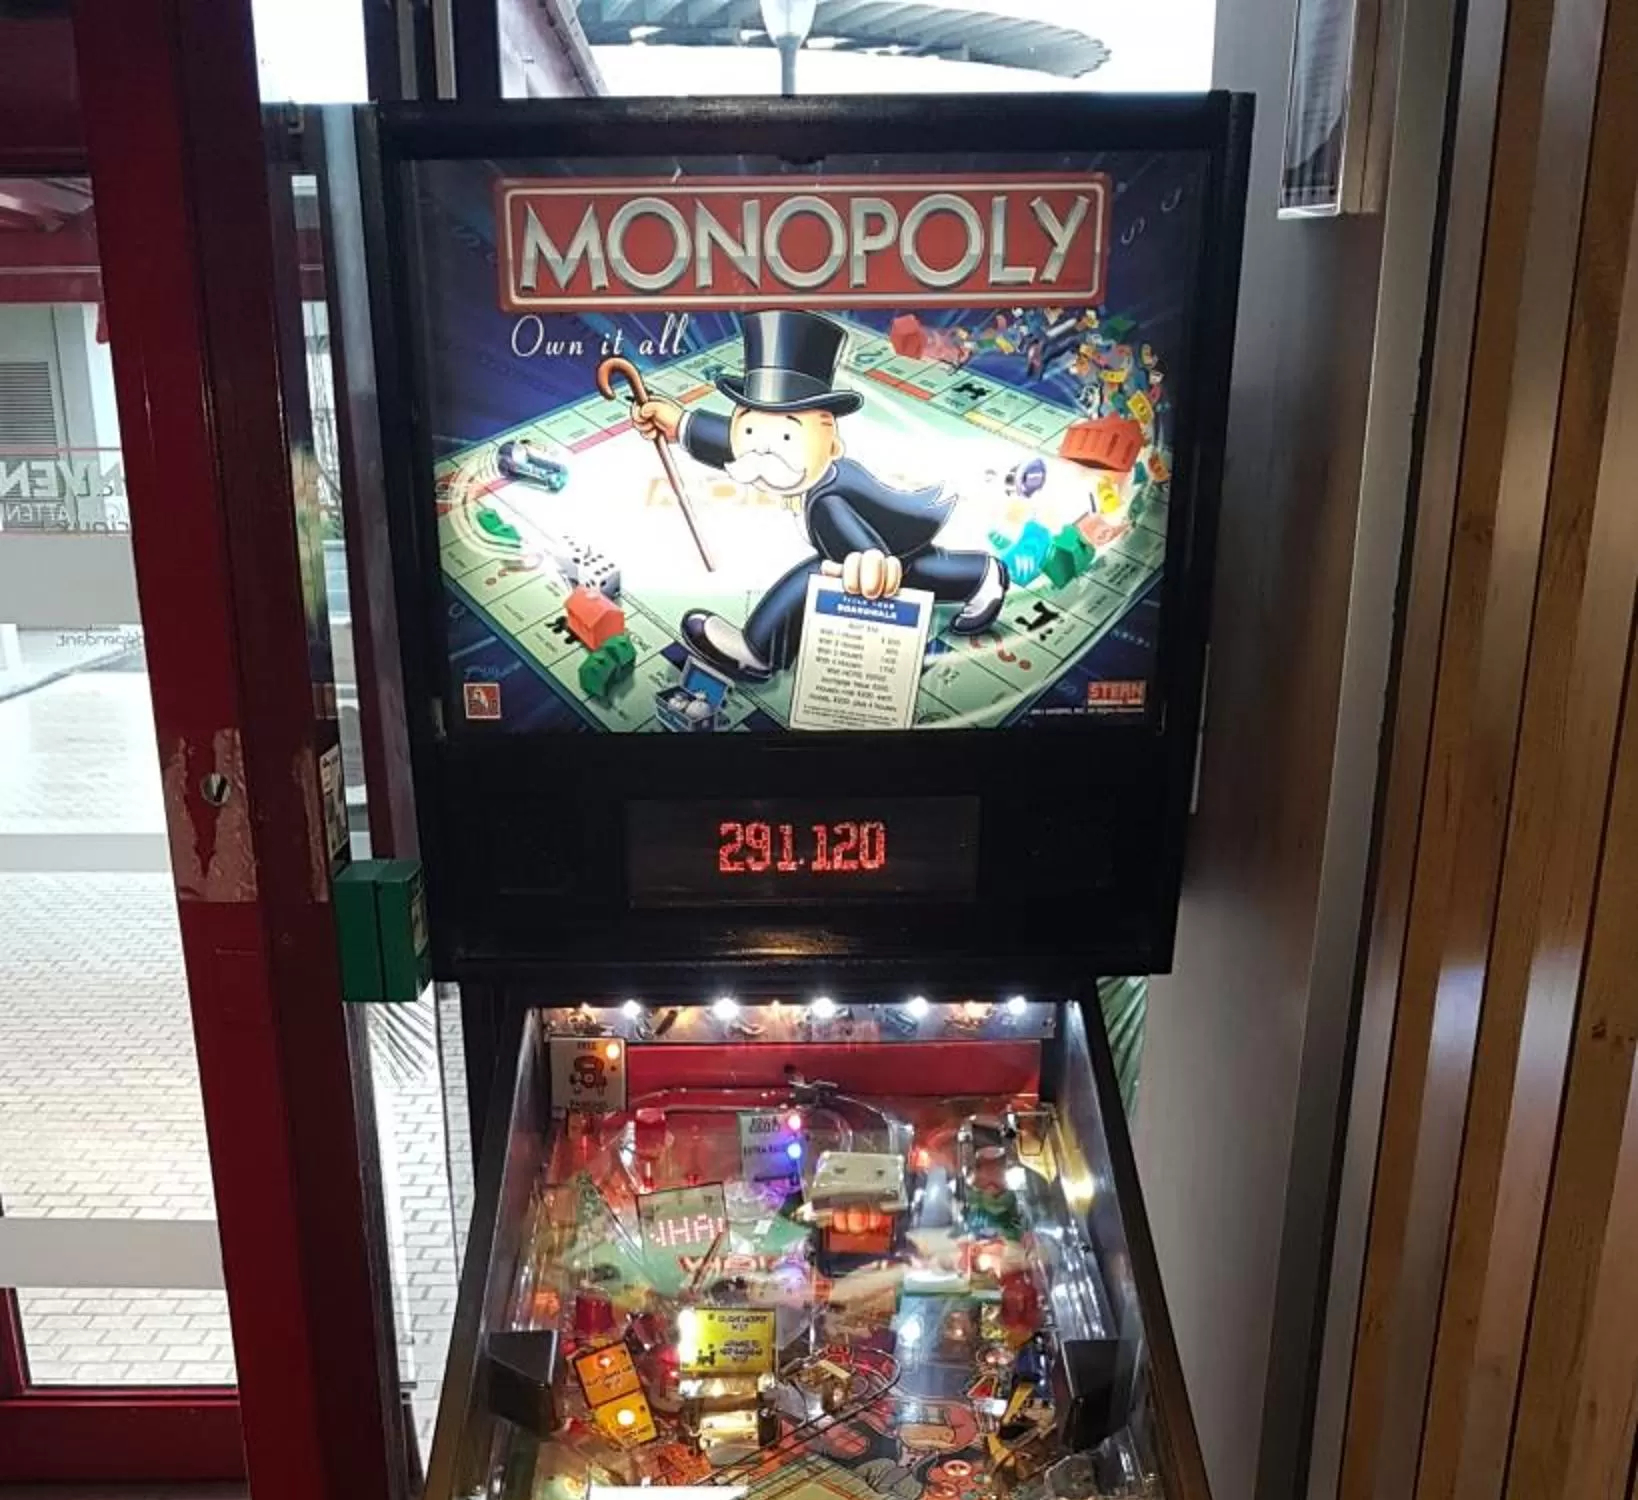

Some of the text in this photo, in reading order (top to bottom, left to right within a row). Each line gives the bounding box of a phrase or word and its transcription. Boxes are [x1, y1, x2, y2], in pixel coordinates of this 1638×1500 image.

[518, 193, 1090, 290] MONOPOLY
[510, 313, 687, 357] Own it all
